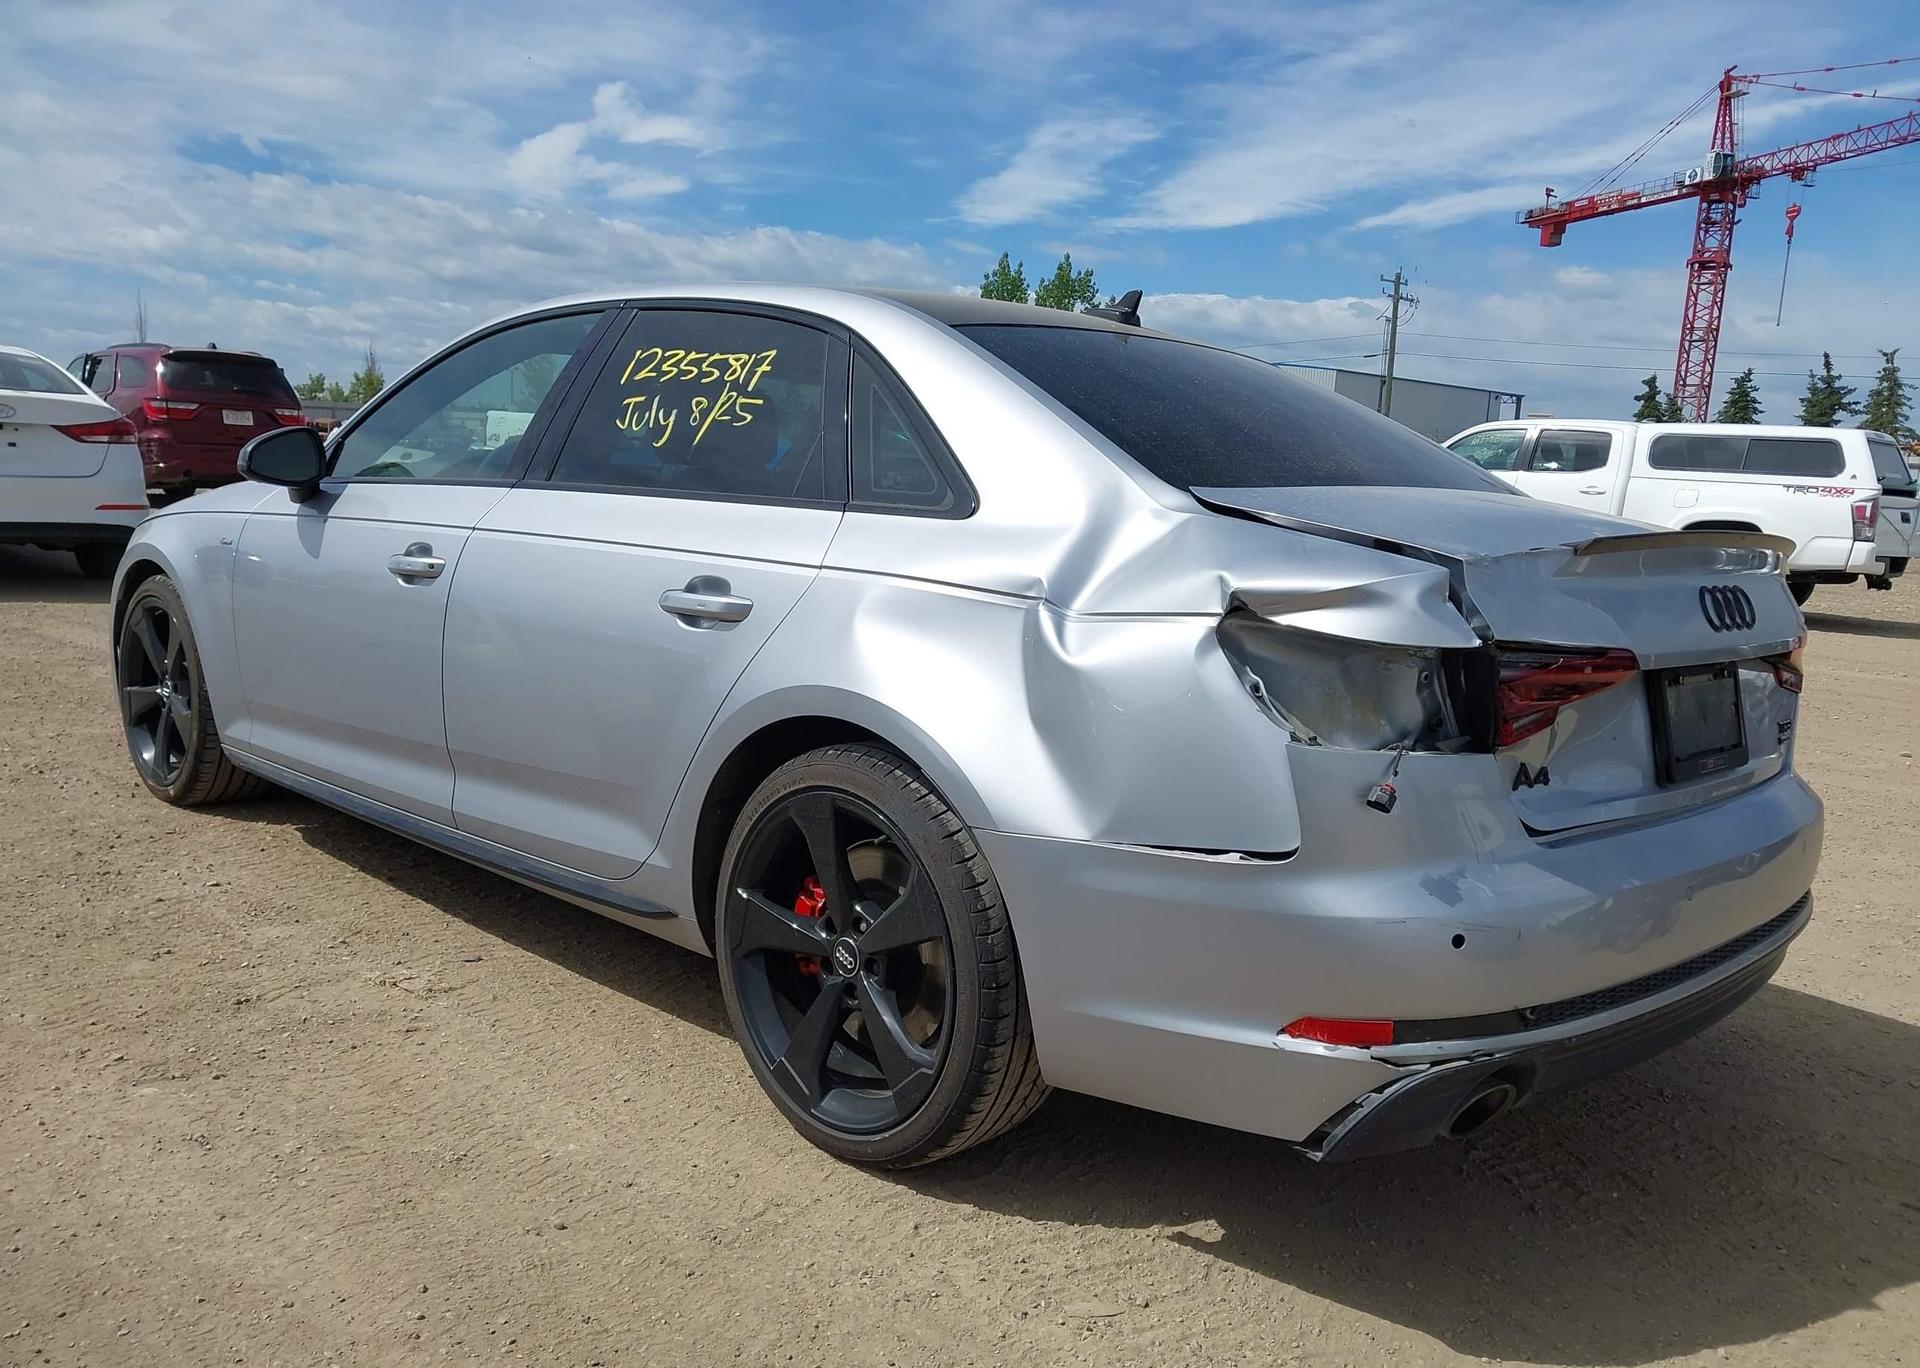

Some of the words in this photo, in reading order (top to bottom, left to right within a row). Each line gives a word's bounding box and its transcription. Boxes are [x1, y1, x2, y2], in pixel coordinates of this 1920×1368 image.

[620, 347, 778, 392] 12355817
[615, 394, 678, 447] July
[689, 382, 764, 446] 8/25
[1511, 762, 1551, 791] A4
